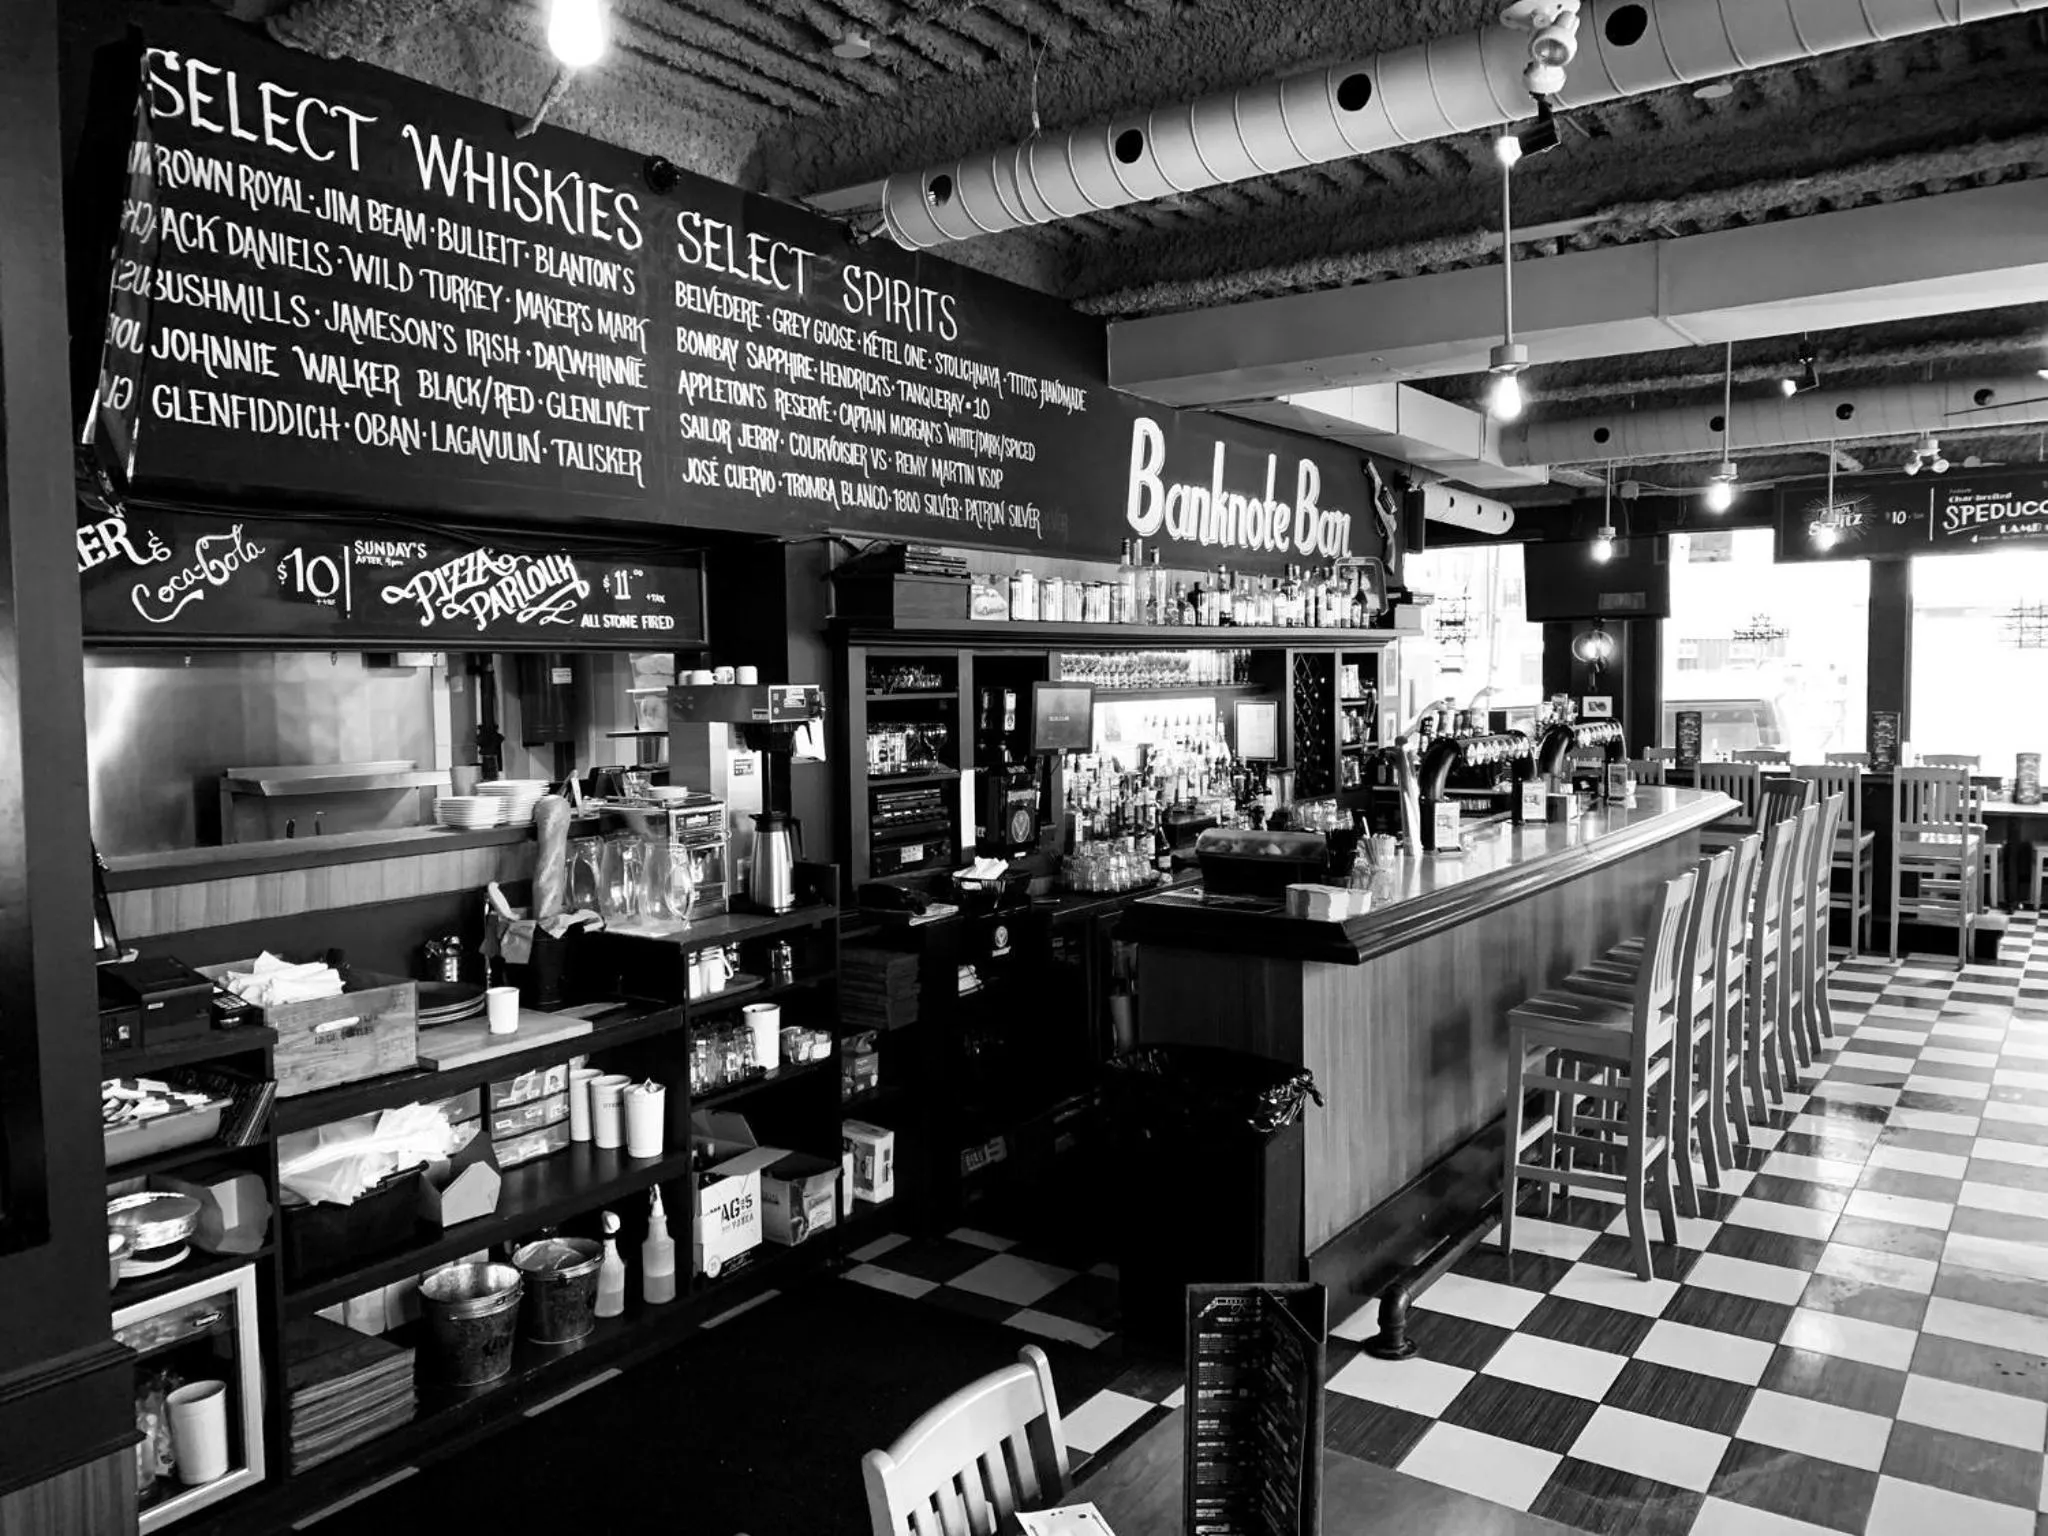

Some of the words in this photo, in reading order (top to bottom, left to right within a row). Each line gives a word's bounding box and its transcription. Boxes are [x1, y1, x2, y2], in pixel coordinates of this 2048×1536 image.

[145, 47, 378, 171] SELECT
[402, 122, 645, 251] WHISKIES
[154, 145, 234, 197] ROWN
[238, 161, 310, 214] ROYAL
[315, 189, 364, 233] JIM
[367, 197, 427, 249] BEAM
[437, 214, 523, 270] BULLEIT
[533, 244, 637, 297] BLANTON'S
[160, 205, 221, 255] ACK
[226, 222, 334, 277] DANIELS
[338, 245, 414, 294] WILD
[420, 268, 505, 317] TURKEY
[514, 289, 593, 334] MAKER'S
[597, 309, 651, 354] MARK
[676, 211, 818, 295] SELECT
[842, 264, 958, 341] SPIRITS
[154, 268, 311, 329] BUSHMILLS
[324, 300, 457, 355] JAMESON'S
[466, 322, 521, 364] IRISH
[532, 340, 648, 390] DALWHINNIE
[675, 280, 764, 333] BELVEDERE
[772, 307, 811, 339] GREY
[813, 319, 856, 351] GOOSE
[863, 330, 902, 365] KETEL
[904, 343, 928, 371] ONE
[935, 352, 1004, 400] STOLICHNAYA
[1007, 371, 1038, 400] TITO'S
[1039, 379, 1087, 415] HANDMADE
[676, 326, 739, 372] BOMBAY
[746, 341, 815, 384] SAPPHIRE
[820, 360, 891, 400] HENDRICK'S
[896, 380, 965, 418] TANQUERAY
[973, 398, 991, 420] 10
[151, 326, 280, 379] JOHNNIE
[292, 345, 403, 406] WALKER
[416, 368, 535, 416] BLACK/RED
[546, 392, 650, 434] GLENLIVET
[678, 369, 768, 406] APPLETON'S
[774, 388, 832, 421] RESERVE
[839, 402, 886, 436] CAPTAIN
[890, 413, 943, 447] MORGAN'S
[151, 384, 340, 442] GLENFIDDICH
[354, 412, 421, 455] OBAN
[430, 424, 542, 466] LAGAVULIN
[550, 438, 645, 488] TALISKER
[680, 413, 732, 453] SAILOR
[738, 423, 780, 455] JERRY
[789, 432, 870, 479] COURVOISIER
[871, 447, 888, 471] VS
[896, 450, 928, 477] REMY
[932, 457, 975, 488] MARTIN
[977, 465, 1004, 490] VSOP
[683, 457, 720, 487] JOSÉ
[724, 463, 776, 498] CUERVO
[783, 472, 840, 511] TROMBA
[842, 484, 888, 511] BLANCO
[893, 489, 921, 514] 1800
[924, 493, 960, 520] SILVER
[965, 498, 1006, 531] PATRON
[1009, 502, 1043, 540] SILVER
[1127, 417, 1291, 552] Banknote
[1294, 458, 1351, 558] Bar
[132, 524, 266, 623] Coca-Cola
[277, 547, 340, 597] $10
[354, 540, 428, 559] SUNDAY'S
[381, 546, 530, 628] PIZZA
[441, 554, 591, 632] PARLOUR
[580, 613, 601, 628] ALL
[602, 614, 638, 628] STONE
[641, 614, 675, 630] FIRED
